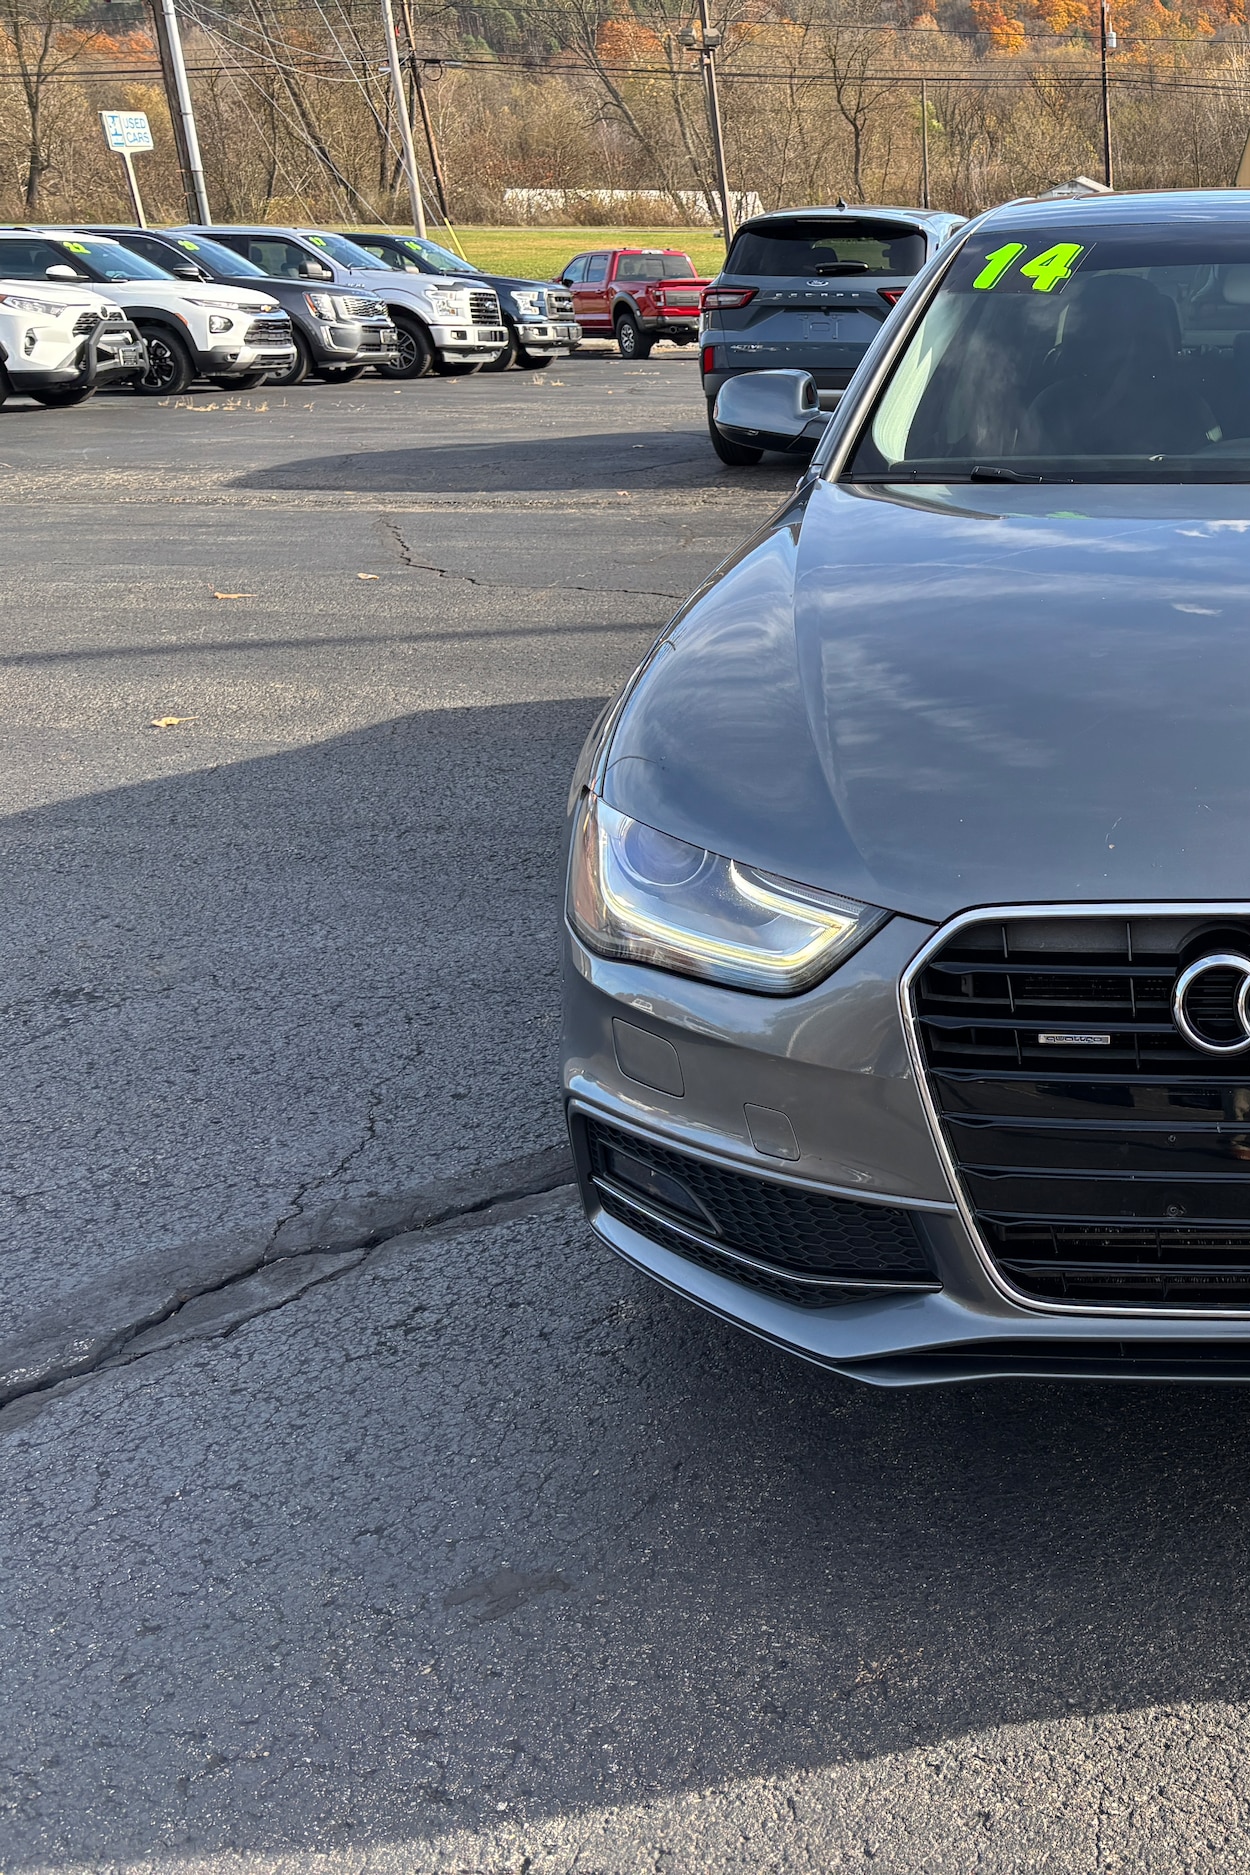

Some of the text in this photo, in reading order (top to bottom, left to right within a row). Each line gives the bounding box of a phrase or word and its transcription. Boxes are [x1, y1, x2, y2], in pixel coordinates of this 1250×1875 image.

[123, 117, 146, 129] USED
[126, 132, 150, 143] CARS
[973, 242, 1085, 292] 14
